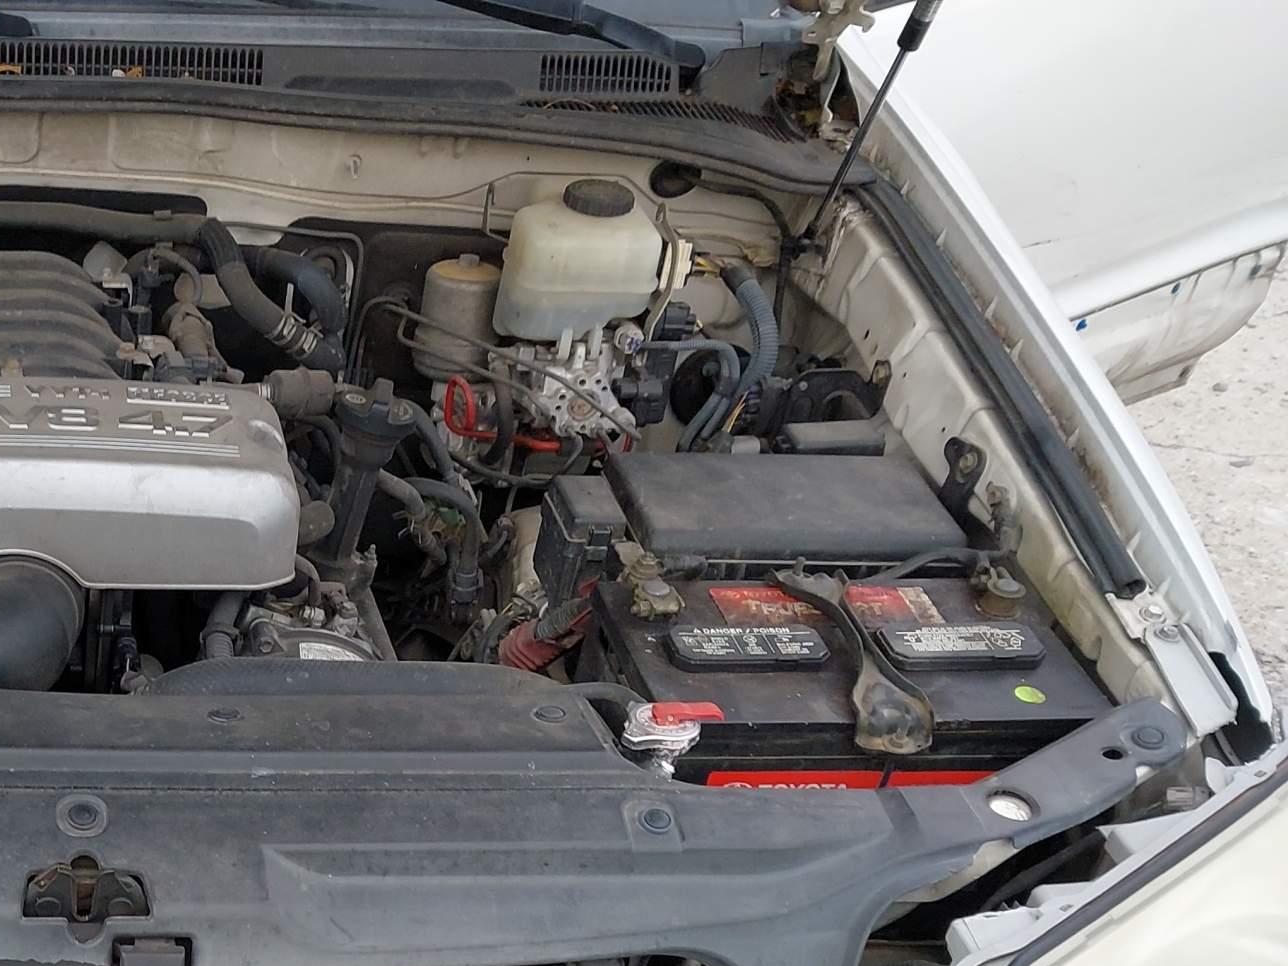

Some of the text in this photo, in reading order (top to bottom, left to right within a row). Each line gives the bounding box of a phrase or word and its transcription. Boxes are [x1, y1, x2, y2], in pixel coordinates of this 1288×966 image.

[117, 409, 233, 439] 4.7
[703, 627, 743, 635] DANGER
[752, 627, 791, 635] POISON
